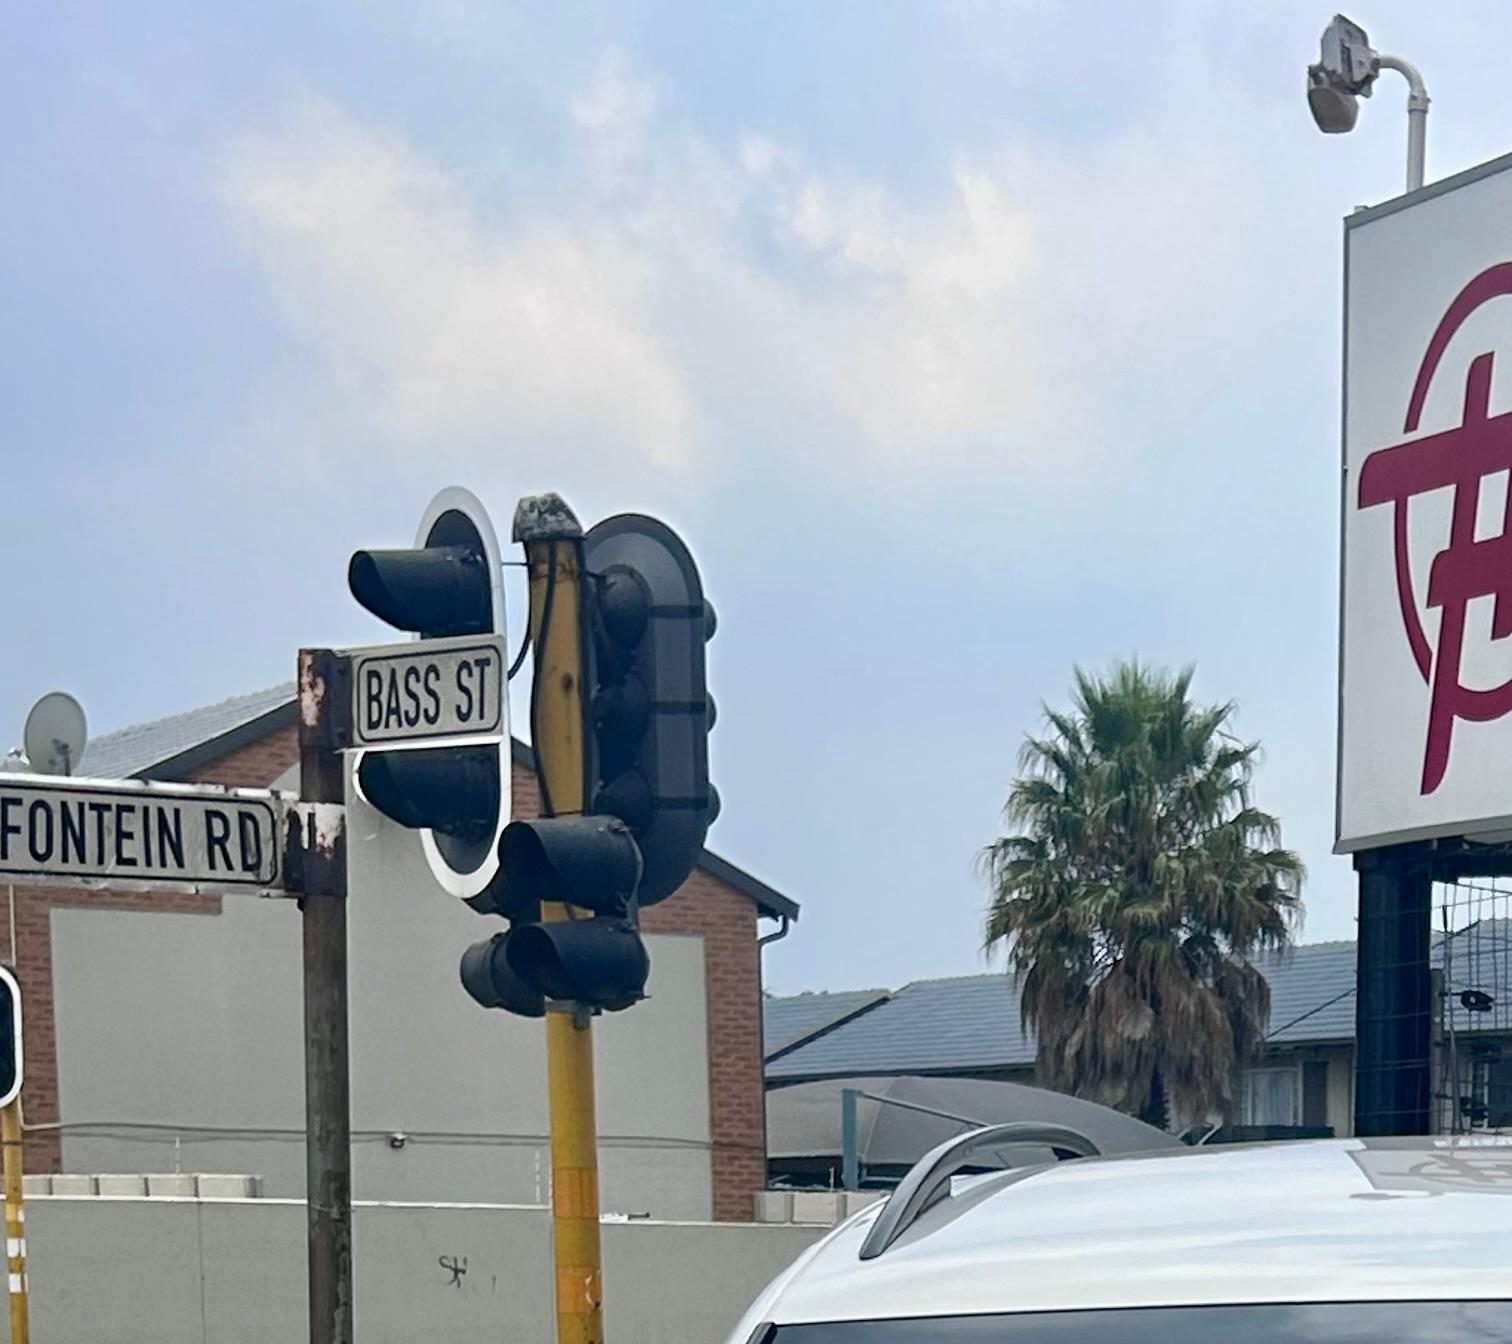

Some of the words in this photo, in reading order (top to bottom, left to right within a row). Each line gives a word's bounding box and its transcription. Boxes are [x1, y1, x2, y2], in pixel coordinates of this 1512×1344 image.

[367, 664, 443, 730] BASS
[456, 657, 491, 722] ST
[0, 797, 185, 869] FONTEIN
[205, 809, 262, 872] RD
